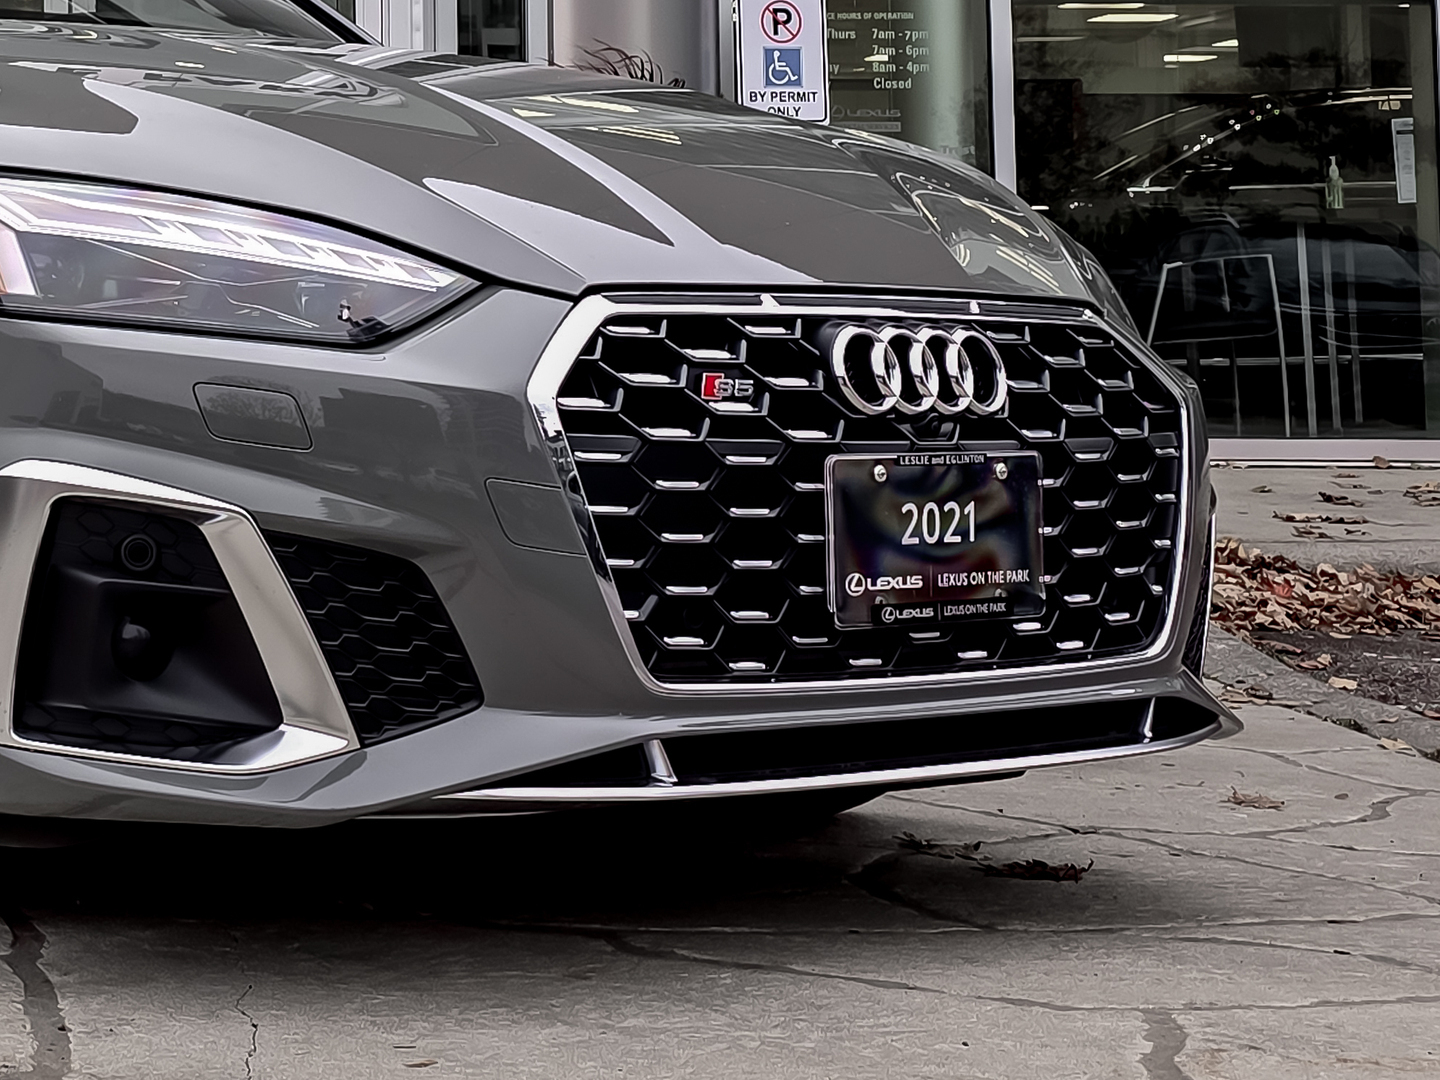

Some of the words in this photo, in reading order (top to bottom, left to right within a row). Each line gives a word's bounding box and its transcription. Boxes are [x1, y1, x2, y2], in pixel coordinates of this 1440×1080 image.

[871, 28, 895, 39] 7am
[905, 30, 928, 42] 7pm
[872, 44, 896, 55] 7am
[906, 45, 929, 58] 6pm
[872, 61, 896, 72] 8am
[906, 61, 930, 74] 4pm
[873, 78, 912, 89] Closed
[749, 91, 766, 102] BY
[770, 91, 818, 102] PERMIT
[900, 456, 929, 465] LESLIE
[931, 456, 944, 464] and
[946, 455, 985, 464] EGLINTON
[901, 500, 975, 545] 2021
[866, 575, 923, 591] LEXUS
[938, 572, 968, 587] LEXUS
[970, 572, 985, 585] ON
[987, 571, 1005, 584] THE
[1006, 570, 1029, 583] PARK
[896, 608, 934, 618] LEXUS
